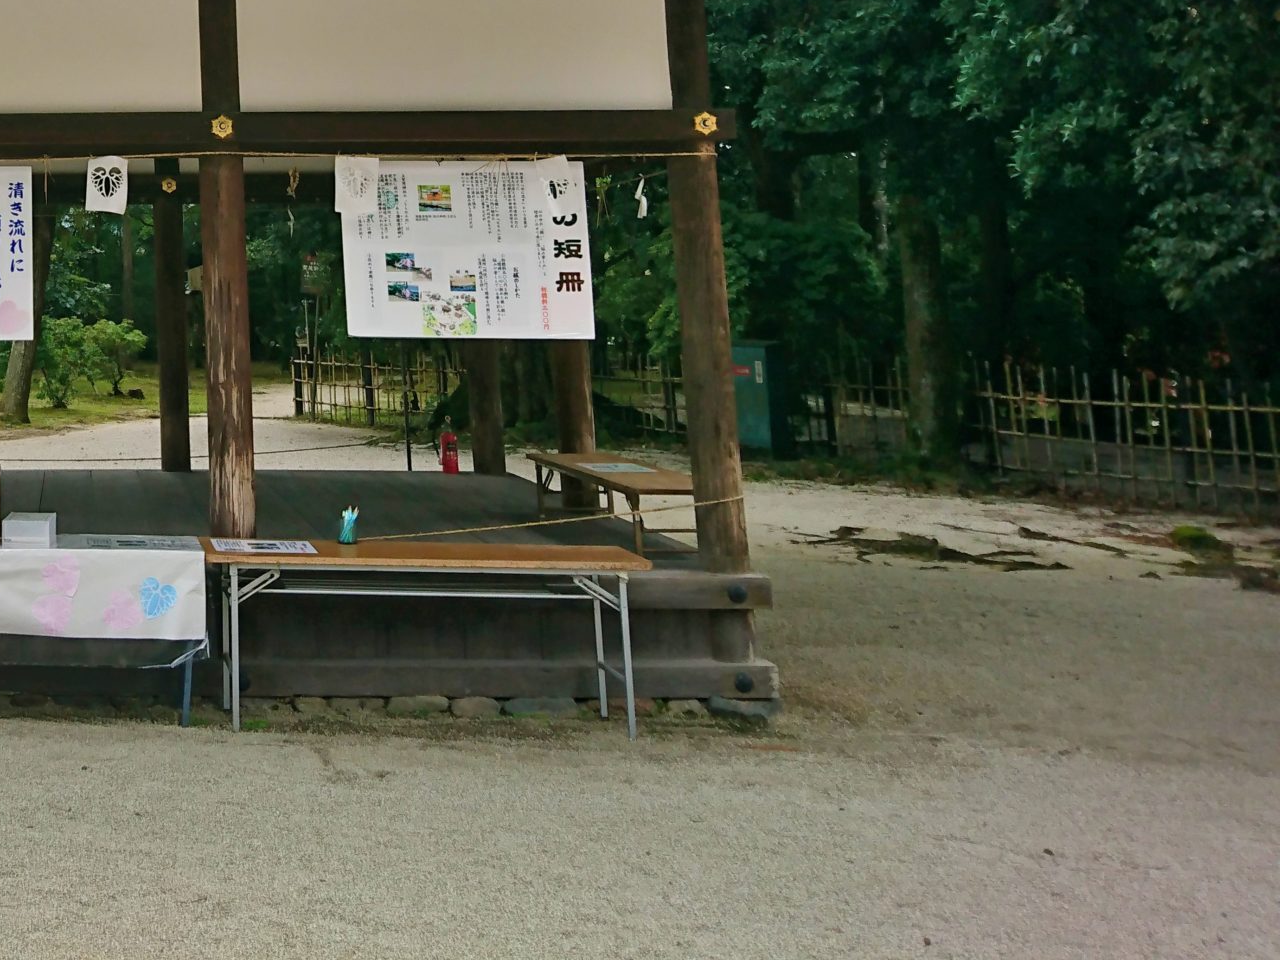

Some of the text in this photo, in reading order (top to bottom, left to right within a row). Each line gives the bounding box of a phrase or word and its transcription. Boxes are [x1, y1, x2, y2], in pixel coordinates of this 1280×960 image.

[8, 182, 25, 273] 清き流れに
